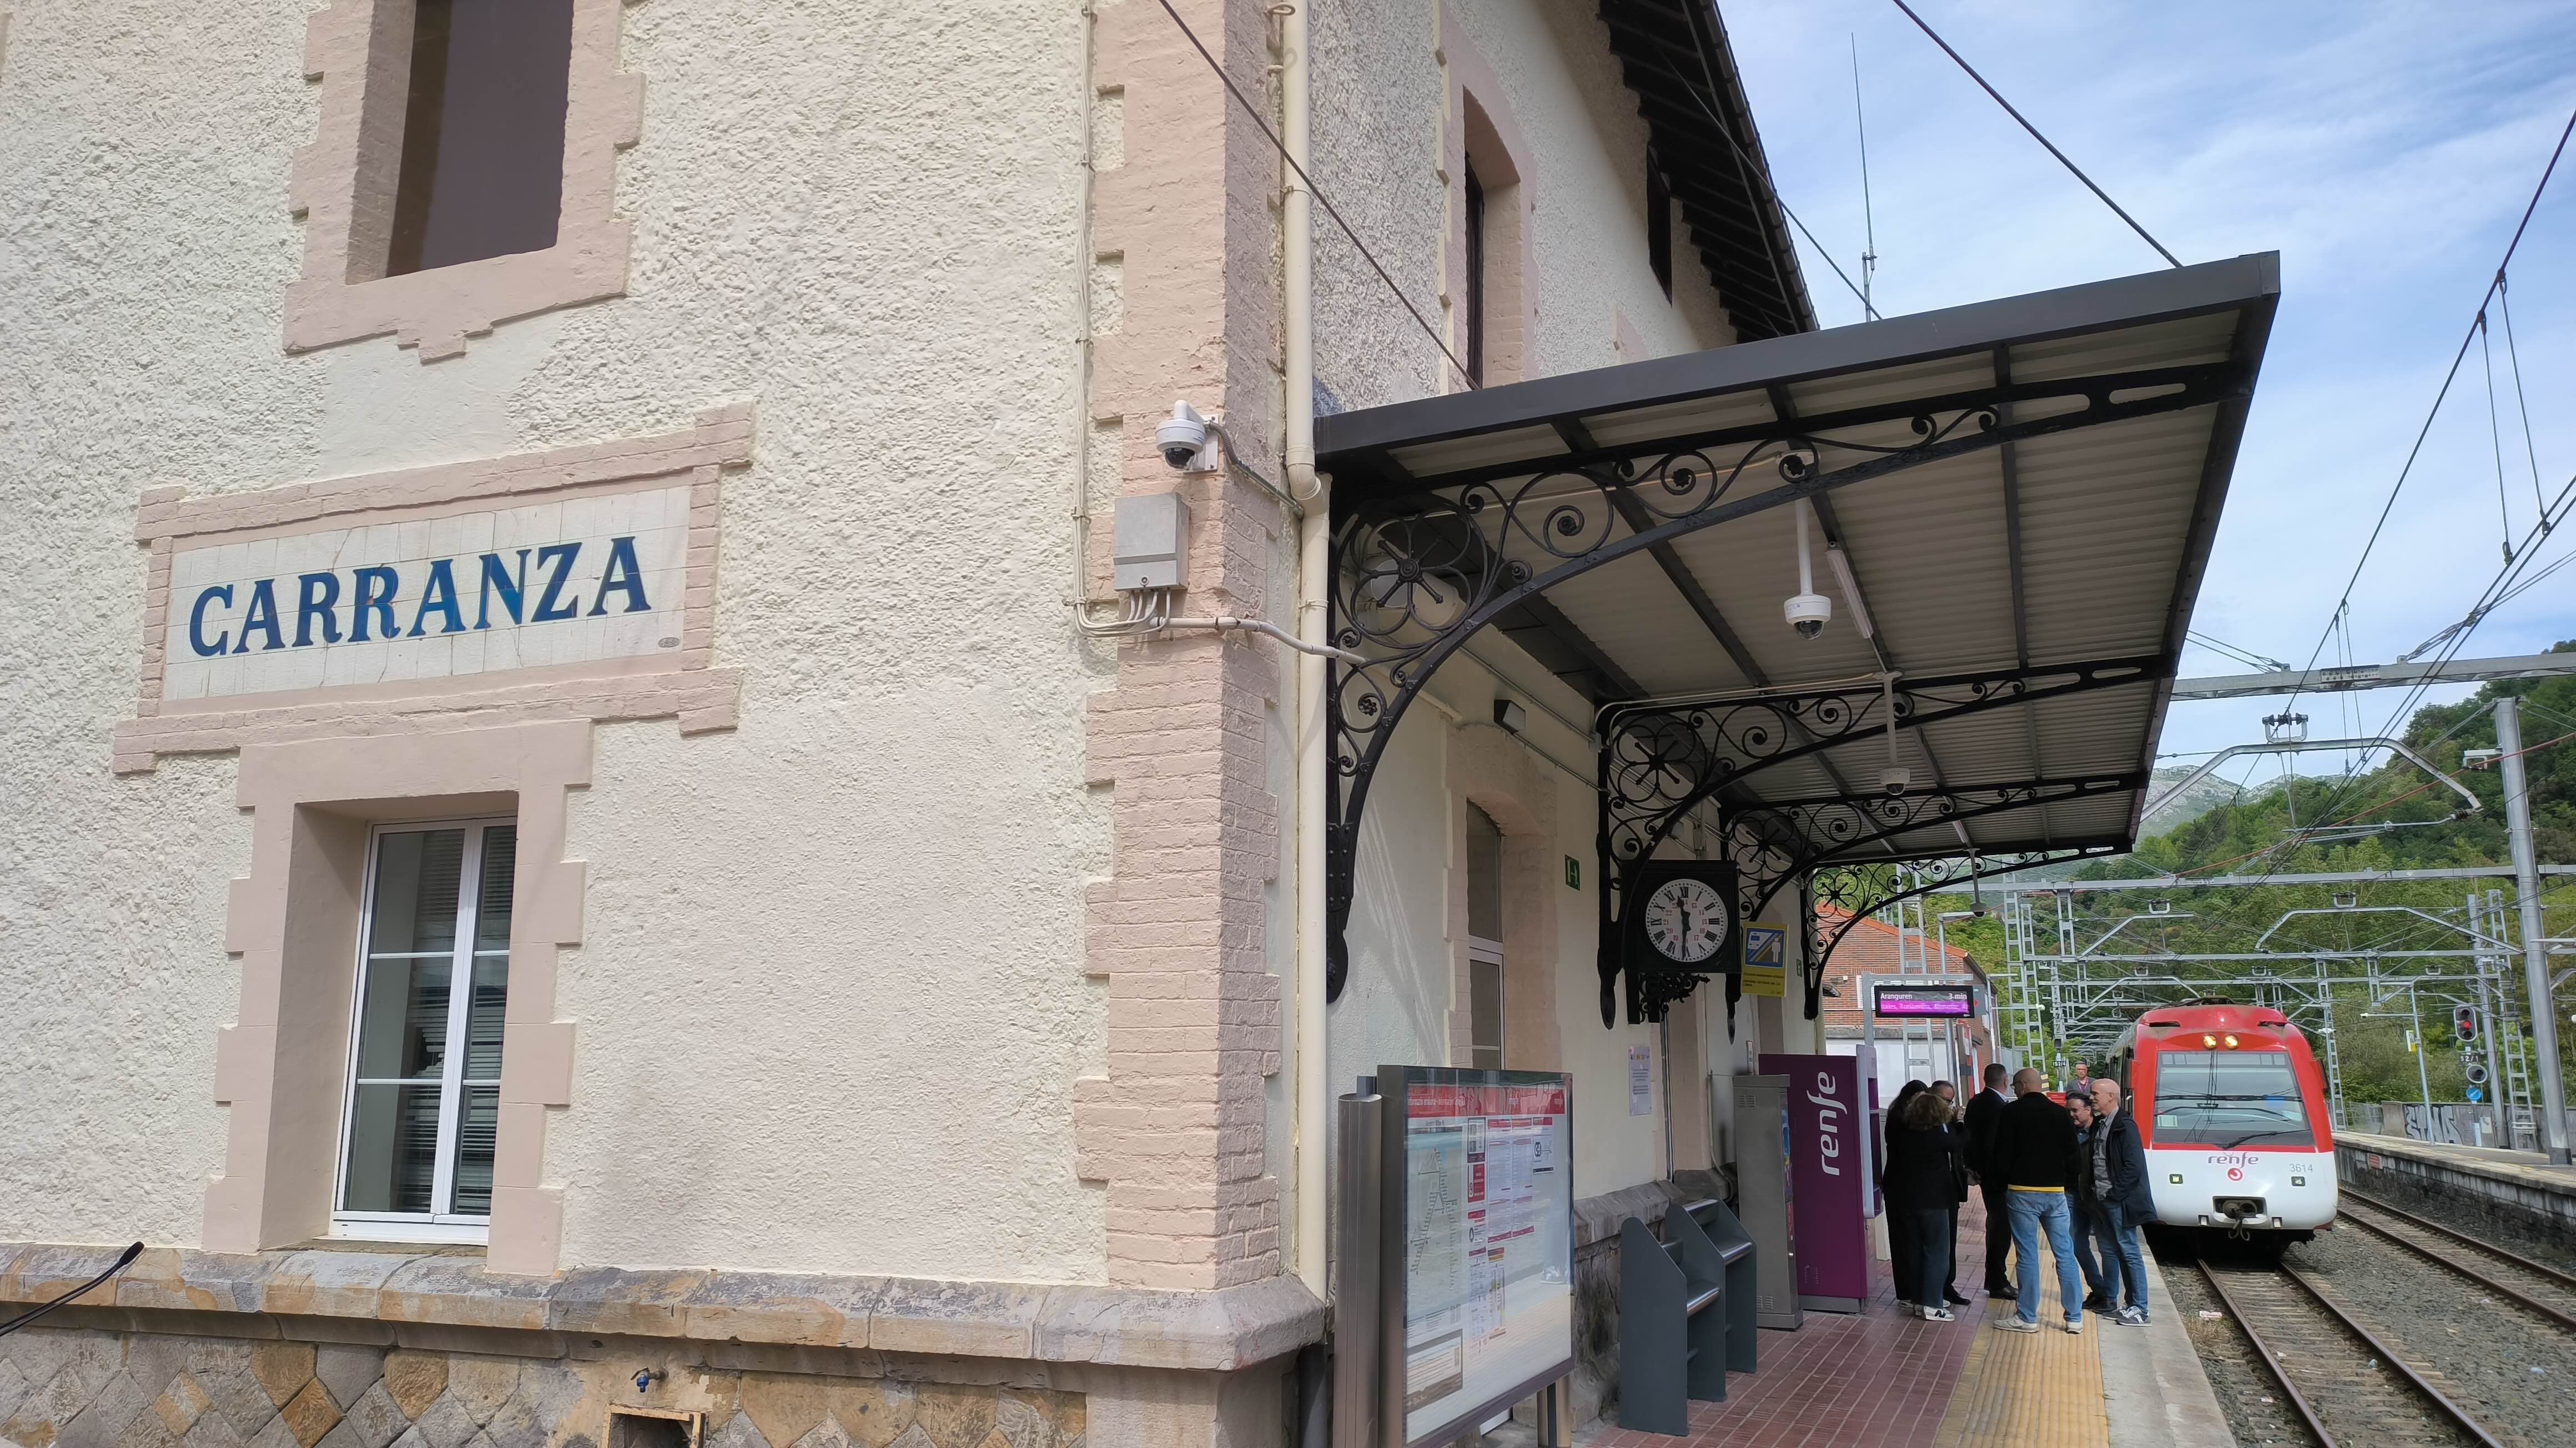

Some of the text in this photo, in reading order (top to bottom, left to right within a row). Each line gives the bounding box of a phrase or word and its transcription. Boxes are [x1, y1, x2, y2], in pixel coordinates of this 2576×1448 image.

[189, 536, 651, 656] CARRANZA
[1806, 1072, 1848, 1176] renfe
[2208, 1152, 2259, 1169] renfe
[2289, 1163, 2313, 1173] 3614
